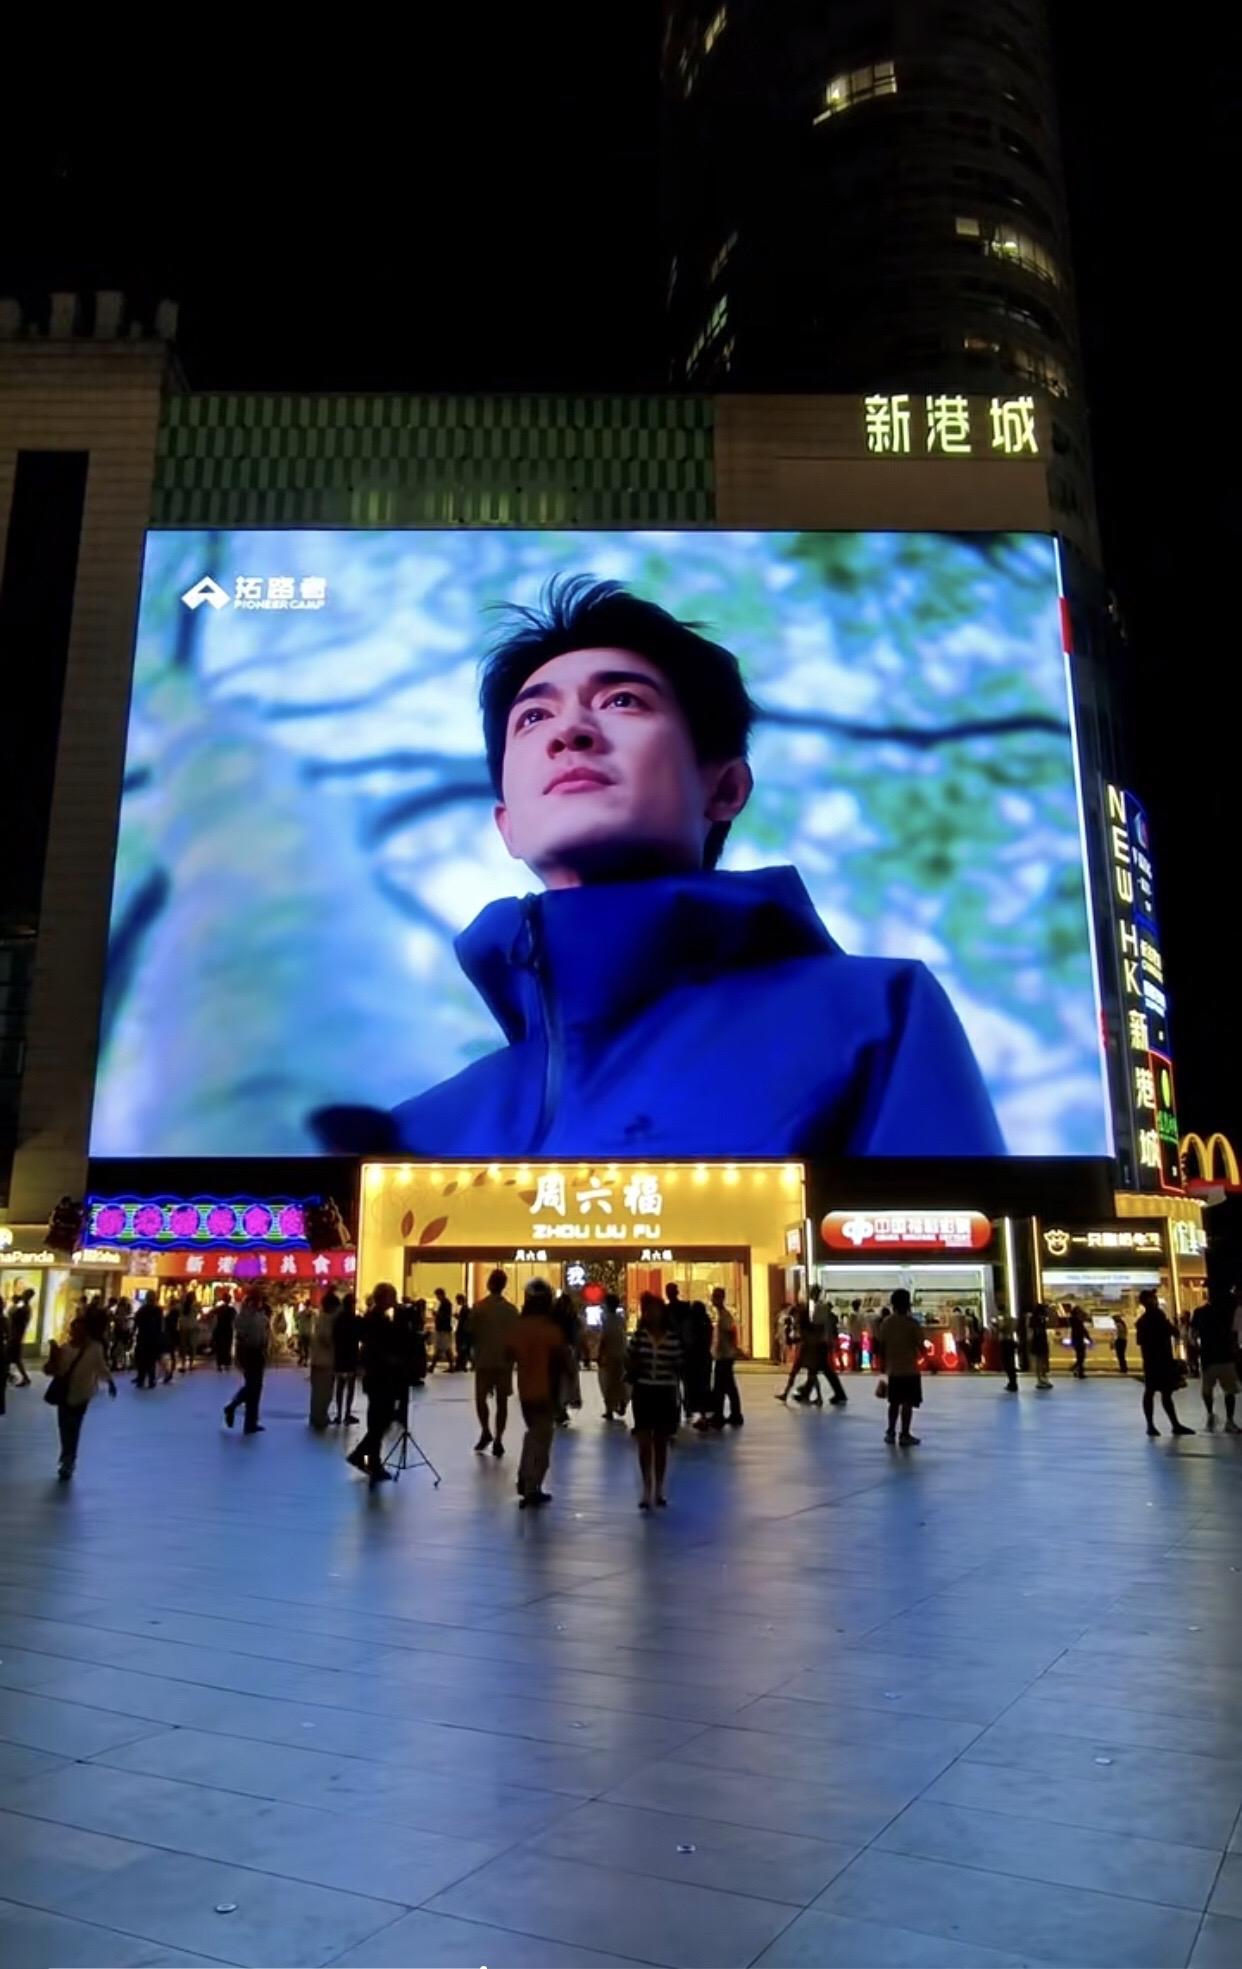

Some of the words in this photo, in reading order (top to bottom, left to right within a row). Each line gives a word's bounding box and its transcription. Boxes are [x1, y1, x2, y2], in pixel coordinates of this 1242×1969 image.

[864, 393, 1039, 454] 新港城
[1106, 785, 1134, 903] NEW
[1120, 919, 1142, 997] HK
[1128, 1010, 1159, 1169] 新港城
[529, 1172, 664, 1217] 周六福
[532, 1223, 590, 1239] ZHOU
[595, 1223, 627, 1239] LIU
[633, 1223, 661, 1239] FU
